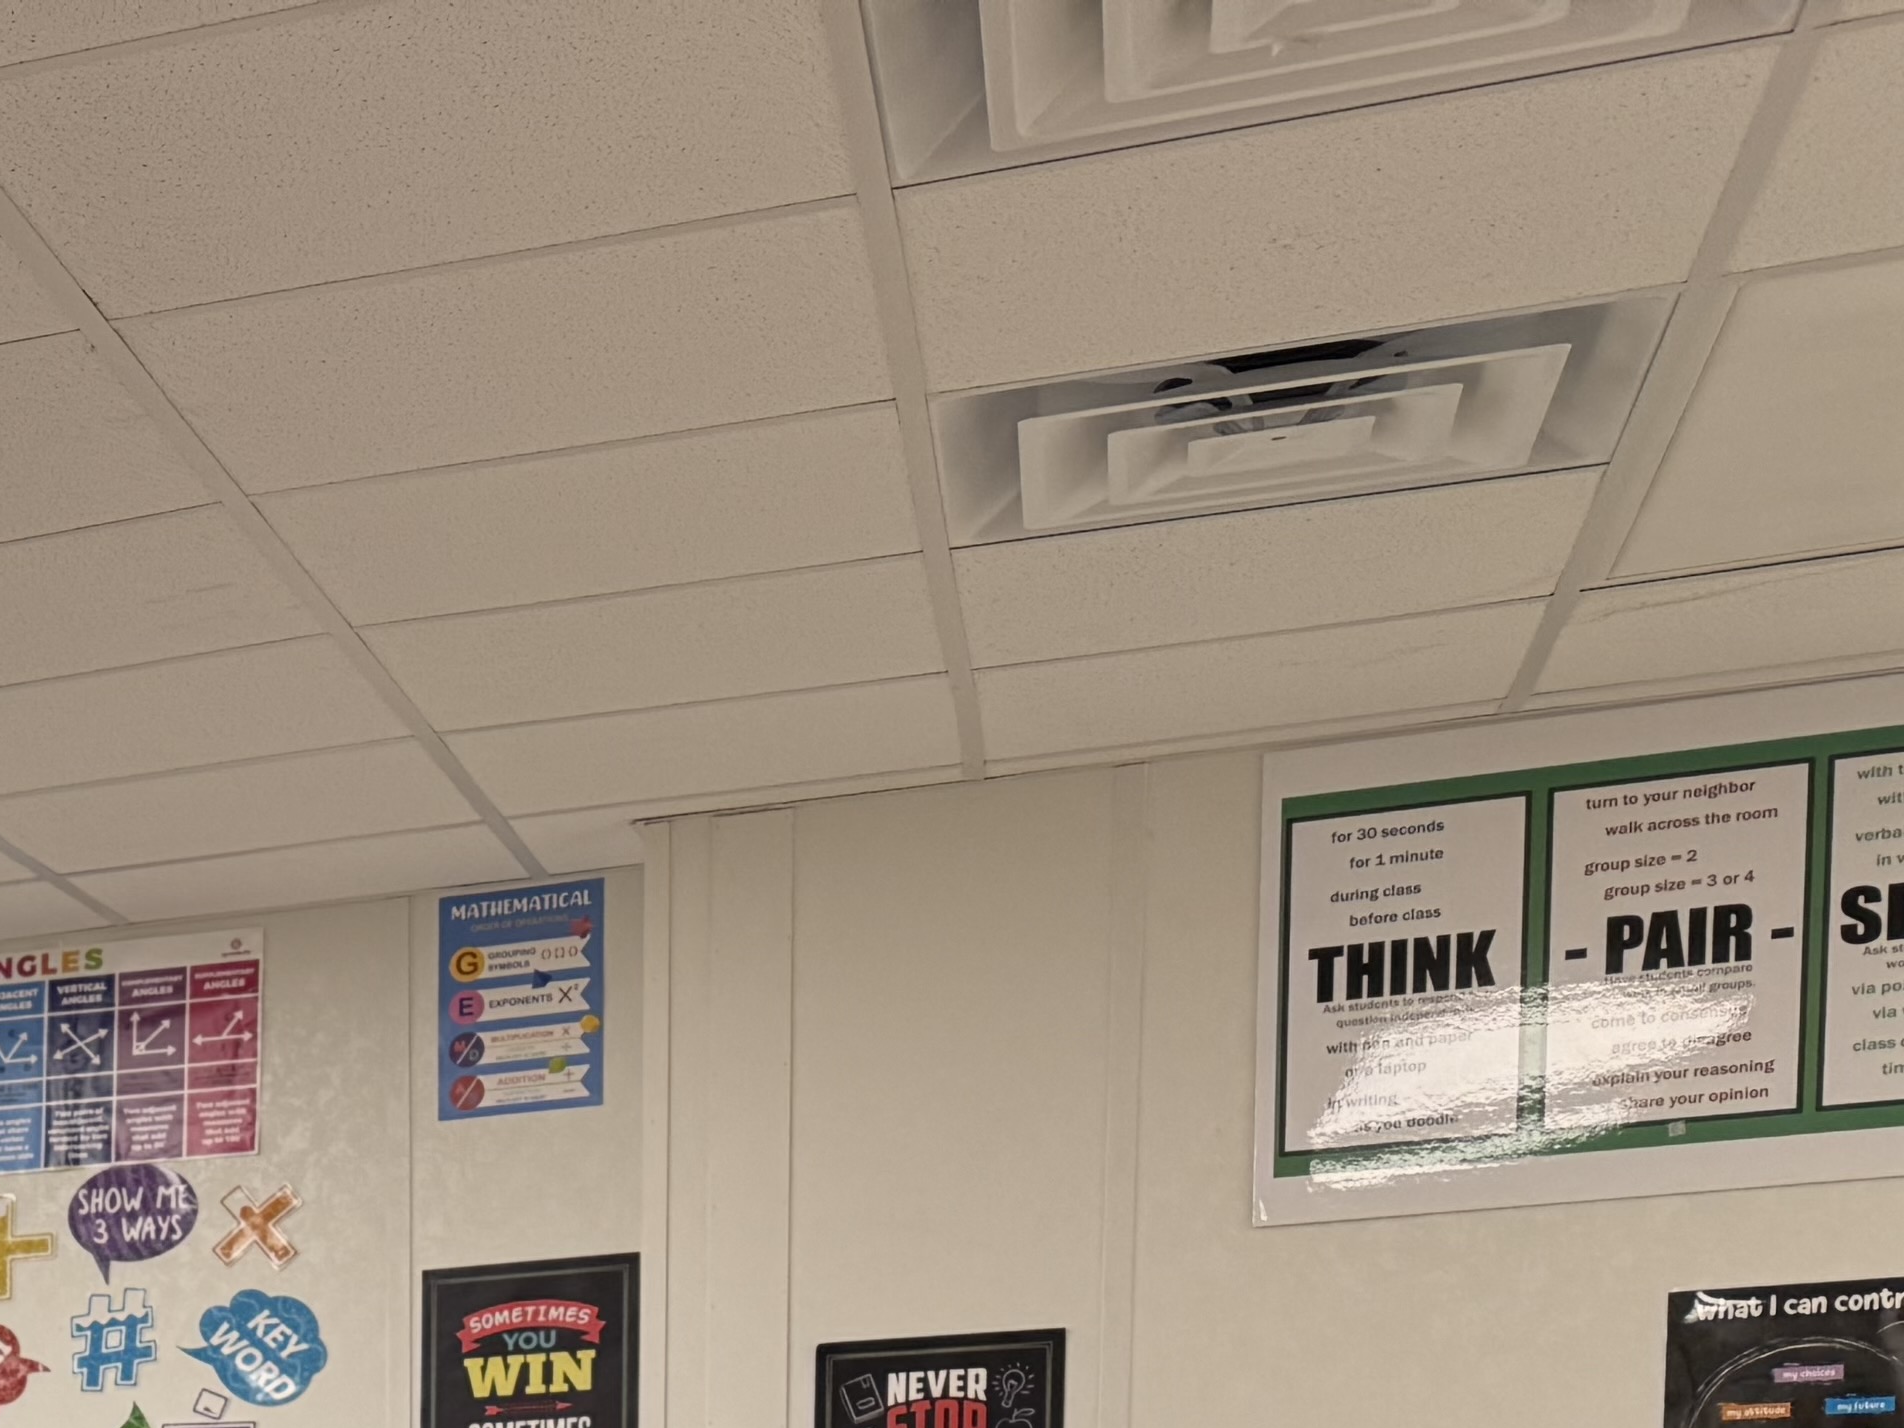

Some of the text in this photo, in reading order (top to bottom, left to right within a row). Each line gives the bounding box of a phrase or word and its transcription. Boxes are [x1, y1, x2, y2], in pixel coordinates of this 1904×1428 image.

[1586, 781, 1756, 810] turn to your neighbor
[1331, 820, 1445, 844] for 30 seconds
[1605, 807, 1779, 836] walk across the room
[1349, 848, 1444, 869] for 1 minute
[1584, 850, 1698, 876] group size 2
[1330, 883, 1422, 903] during class
[1604, 869, 1755, 901] group size 3 or 4
[451, 889, 591, 921] MATHEMATICAL
[1349, 907, 1442, 927] before class
[1605, 903, 1753, 975] PAIR
[455, 951, 479, 975] G
[1308, 929, 1497, 1003] THINK
[57, 981, 108, 995] VERTICAL
[488, 993, 553, 1009] EXPONENTS
[1654, 1066, 1690, 1082] your
[1693, 1058, 1776, 1077] reasoning
[1668, 1091, 1704, 1108] your
[1708, 1086, 1769, 1104] opinion
[77, 1183, 189, 1215] SHOW ME
[94, 1214, 183, 1244] 3 WAYS
[469, 1304, 592, 1334] SOMETIMES
[1783, 1294, 1828, 1315] can
[246, 1308, 311, 1360] KEY
[502, 1330, 557, 1350] YOU
[210, 1321, 297, 1402] WORD
[463, 1349, 596, 1399] WIN
[887, 1367, 988, 1407] NEVER
